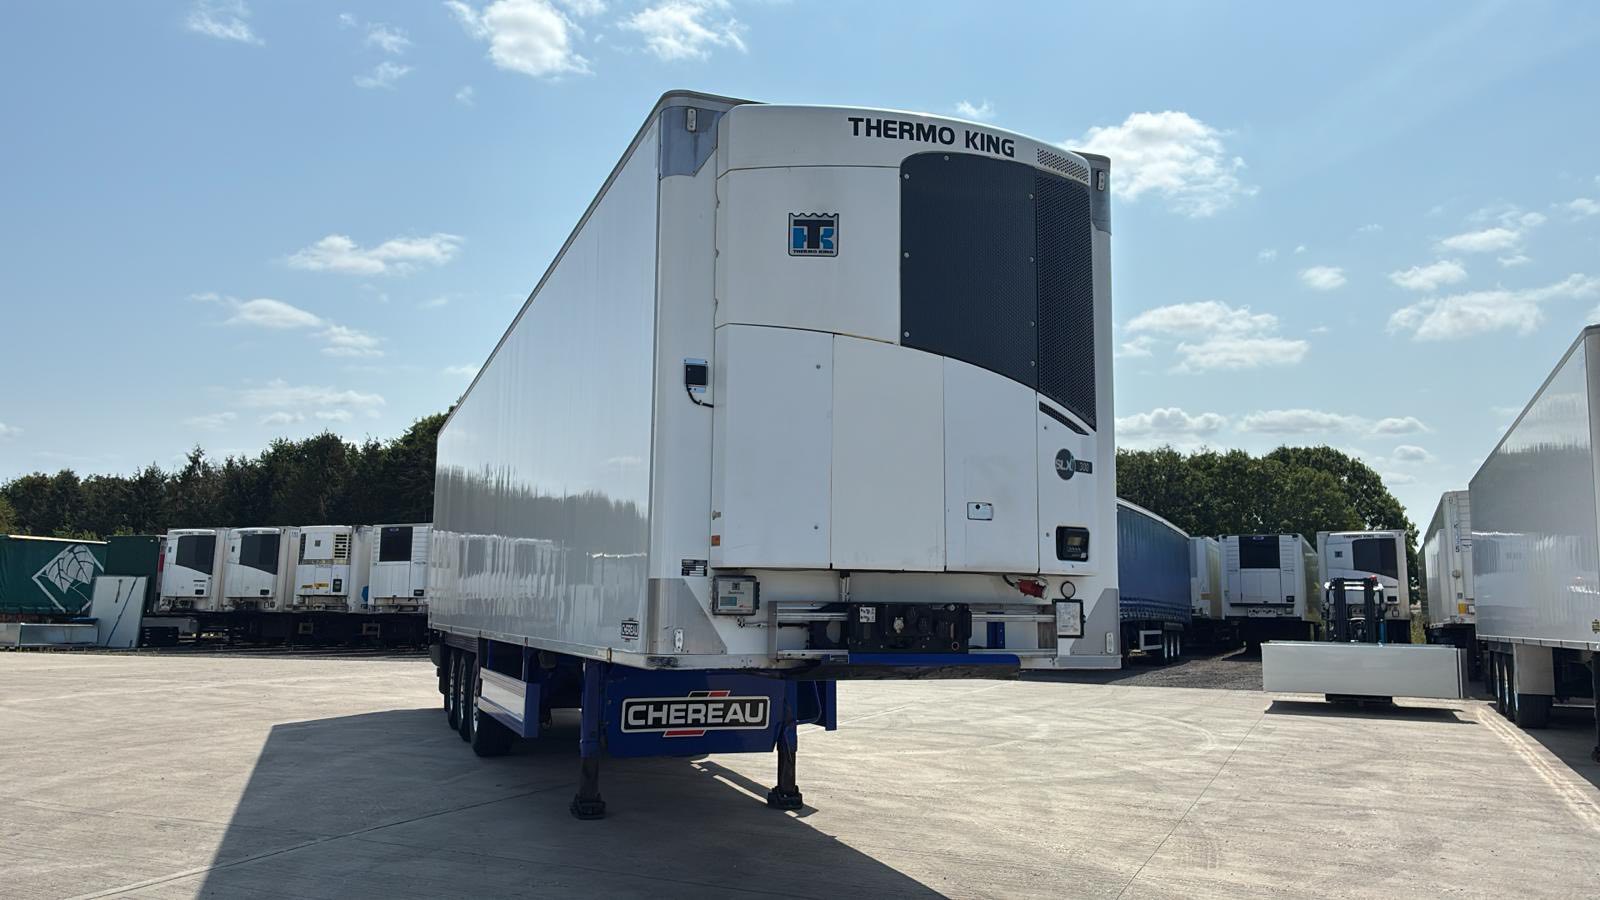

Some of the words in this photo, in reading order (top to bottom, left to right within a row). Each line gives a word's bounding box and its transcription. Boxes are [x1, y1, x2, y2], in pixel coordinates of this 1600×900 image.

[848, 117, 955, 145] THERMO
[965, 130, 1015, 158] KING
[627, 703, 764, 726] CHEREAU
